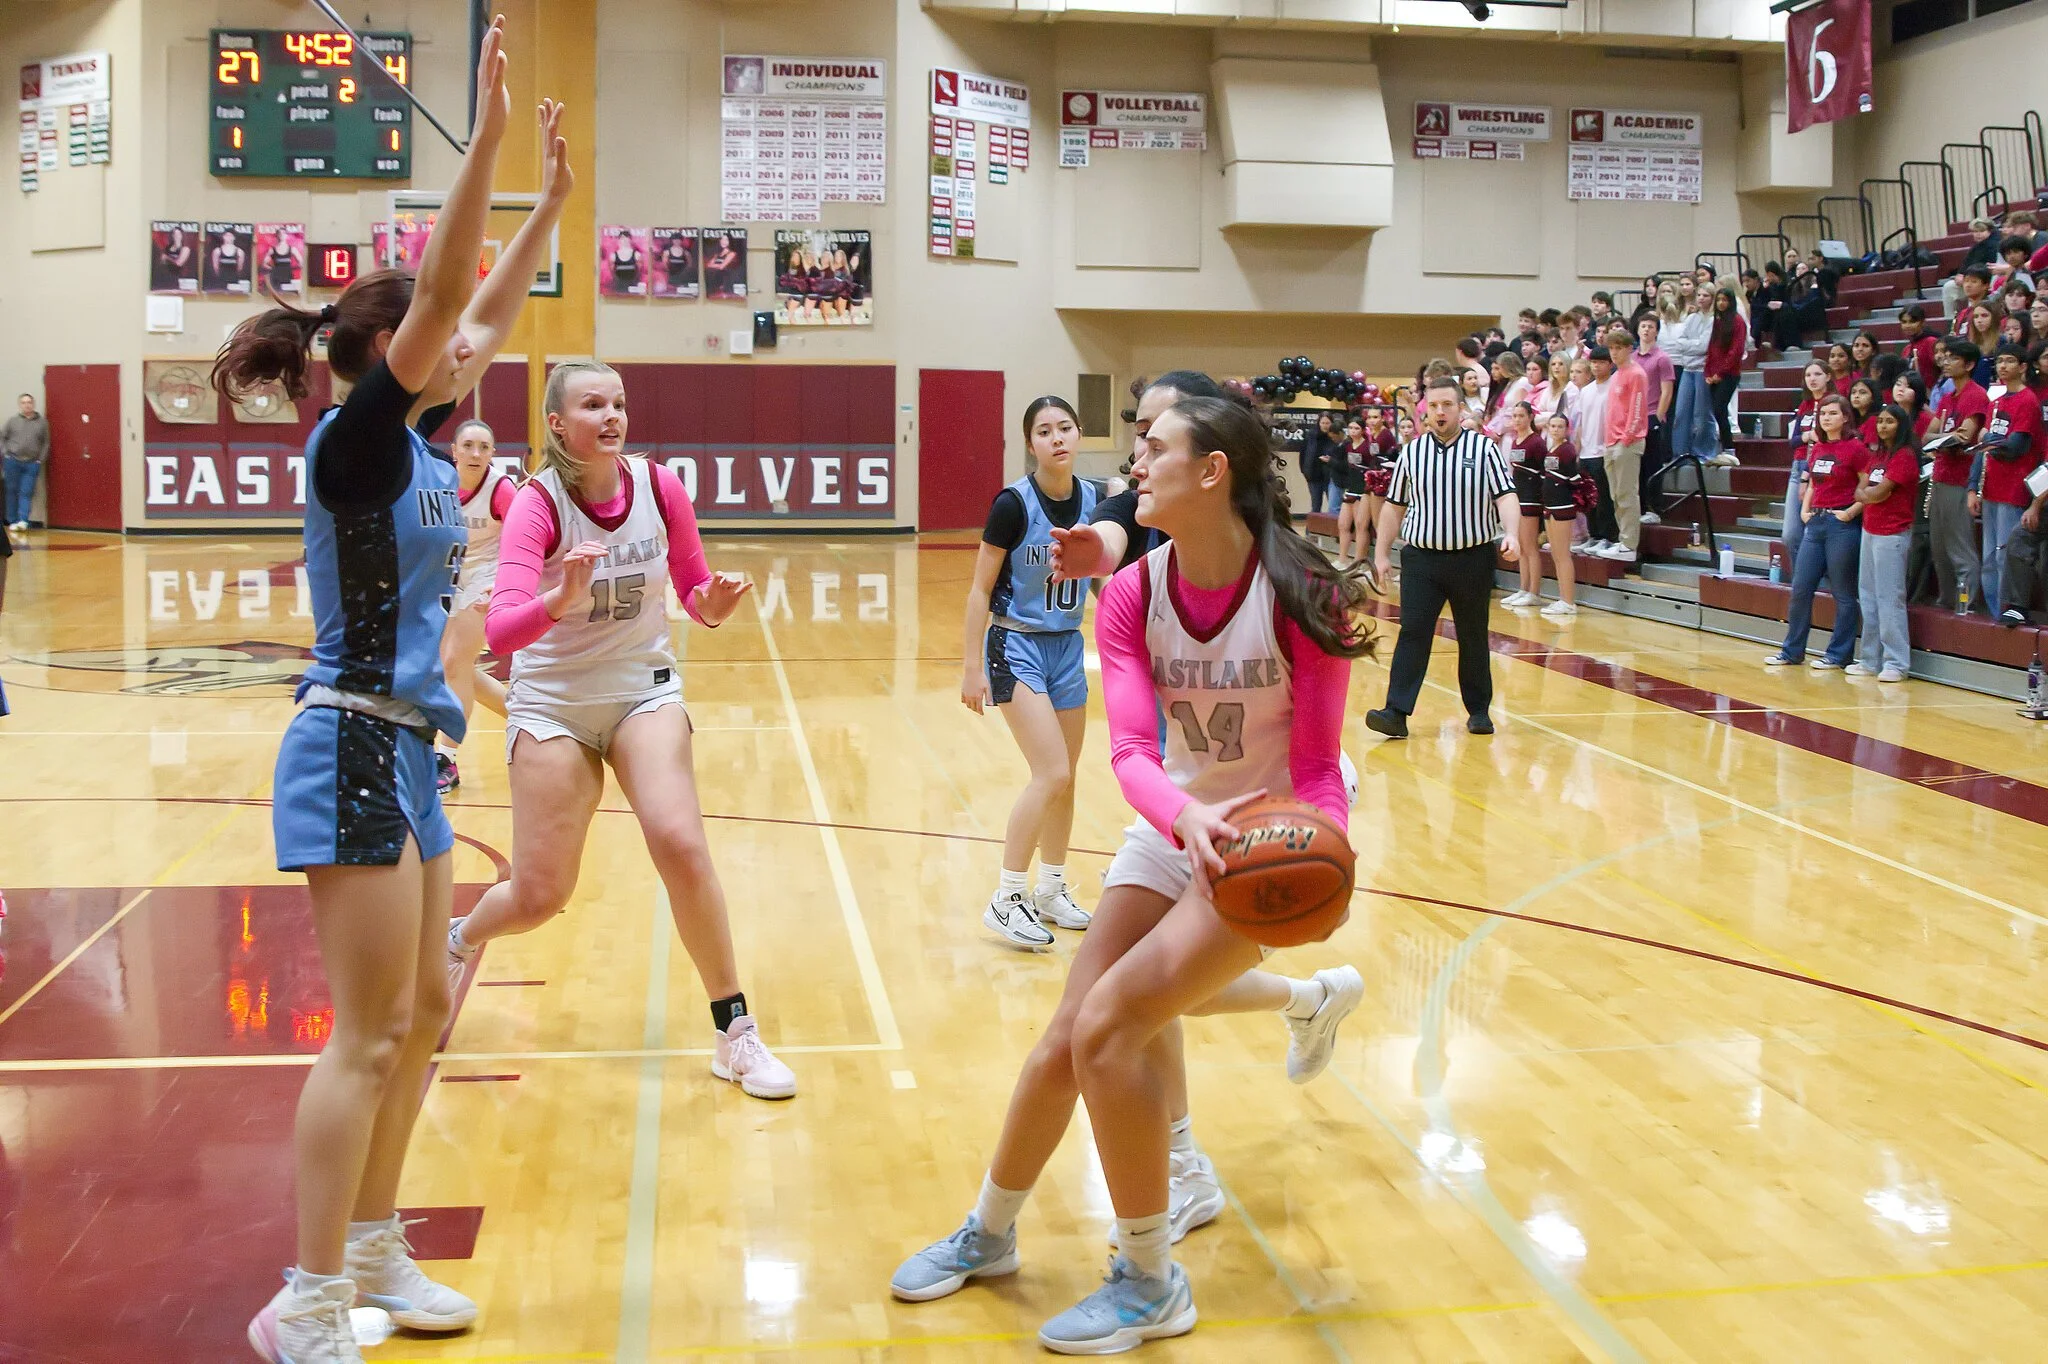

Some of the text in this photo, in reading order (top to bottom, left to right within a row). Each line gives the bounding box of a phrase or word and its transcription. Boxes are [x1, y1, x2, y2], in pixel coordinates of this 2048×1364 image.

[286, 33, 353, 66] 4:52
[218, 51, 260, 84] 27
[385, 55, 406, 85] 4
[1808, 18, 1838, 104] 6
[772, 63, 879, 79] INDIVIDUAL
[290, 78, 356, 103] period 2
[785, 81, 866, 92] CHAMPIONS
[963, 79, 992, 96] TRACK
[1004, 85, 1028, 101] FIELD
[290, 106, 329, 121] player
[971, 96, 1019, 112] CHAMPIONS
[1104, 97, 1201, 112] VOLLEYBALL
[1116, 113, 1188, 124] CHAMPIONS
[1457, 109, 1546, 124] WRESTLING
[1613, 116, 1694, 130] ACADEMIC
[233, 126, 242, 149] 1
[825, 131, 850, 139] 2011
[1467, 125, 1534, 135] CHAMPIONS
[1620, 131, 1686, 141] CHAMPIONS
[390, 129, 400, 151] 1
[758, 150, 784, 158] 2012
[856, 152, 882, 160] 2014
[757, 171, 784, 179] 2014
[791, 172, 816, 180] 2014
[1572, 172, 1593, 180] 2011
[1625, 173, 1647, 181] 2012
[145, 456, 307, 504] EAST
[666, 457, 889, 504] OLVES
[588, 572, 646, 623] 15
[1044, 572, 1080, 612] 10
[1153, 656, 1282, 690] ASTLAKE
[1169, 700, 1245, 762] 14
